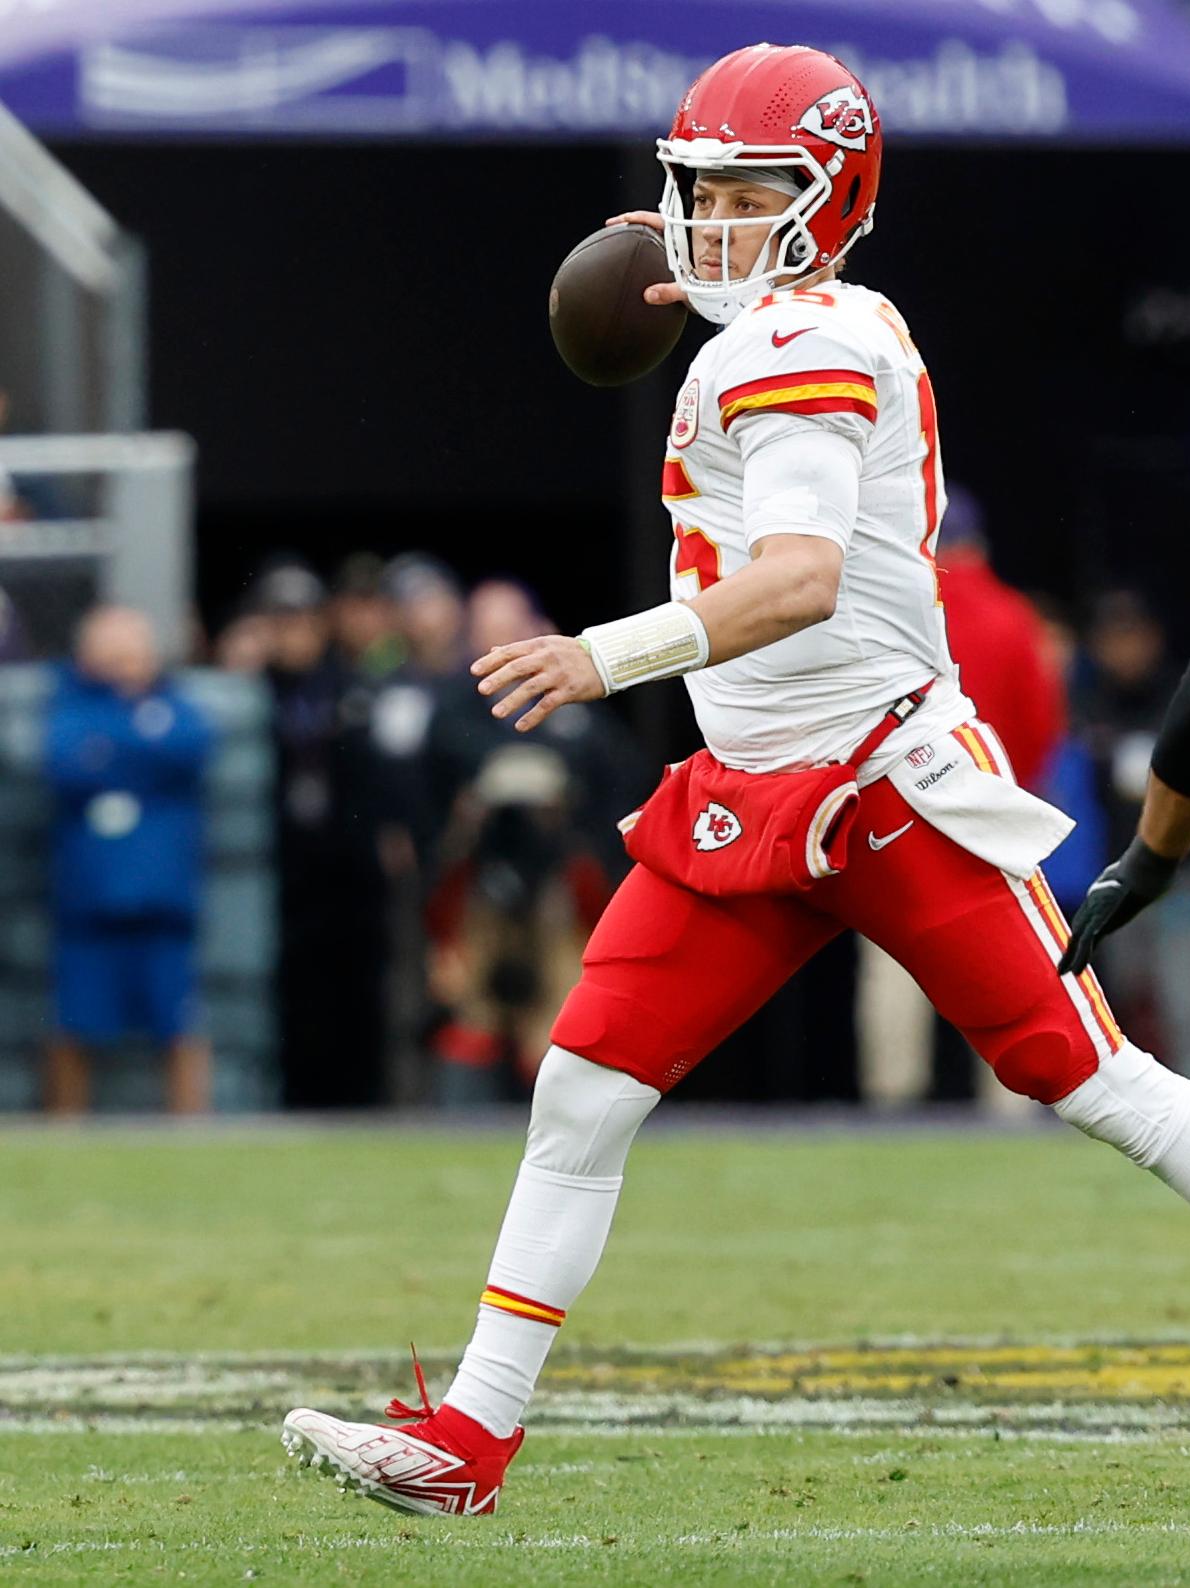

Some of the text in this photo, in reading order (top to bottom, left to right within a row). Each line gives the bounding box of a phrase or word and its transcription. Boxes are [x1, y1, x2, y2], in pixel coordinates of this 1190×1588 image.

[906, 745, 934, 768] NFL
[915, 763, 955, 791] Wilson
[707, 813, 734, 842] KC
